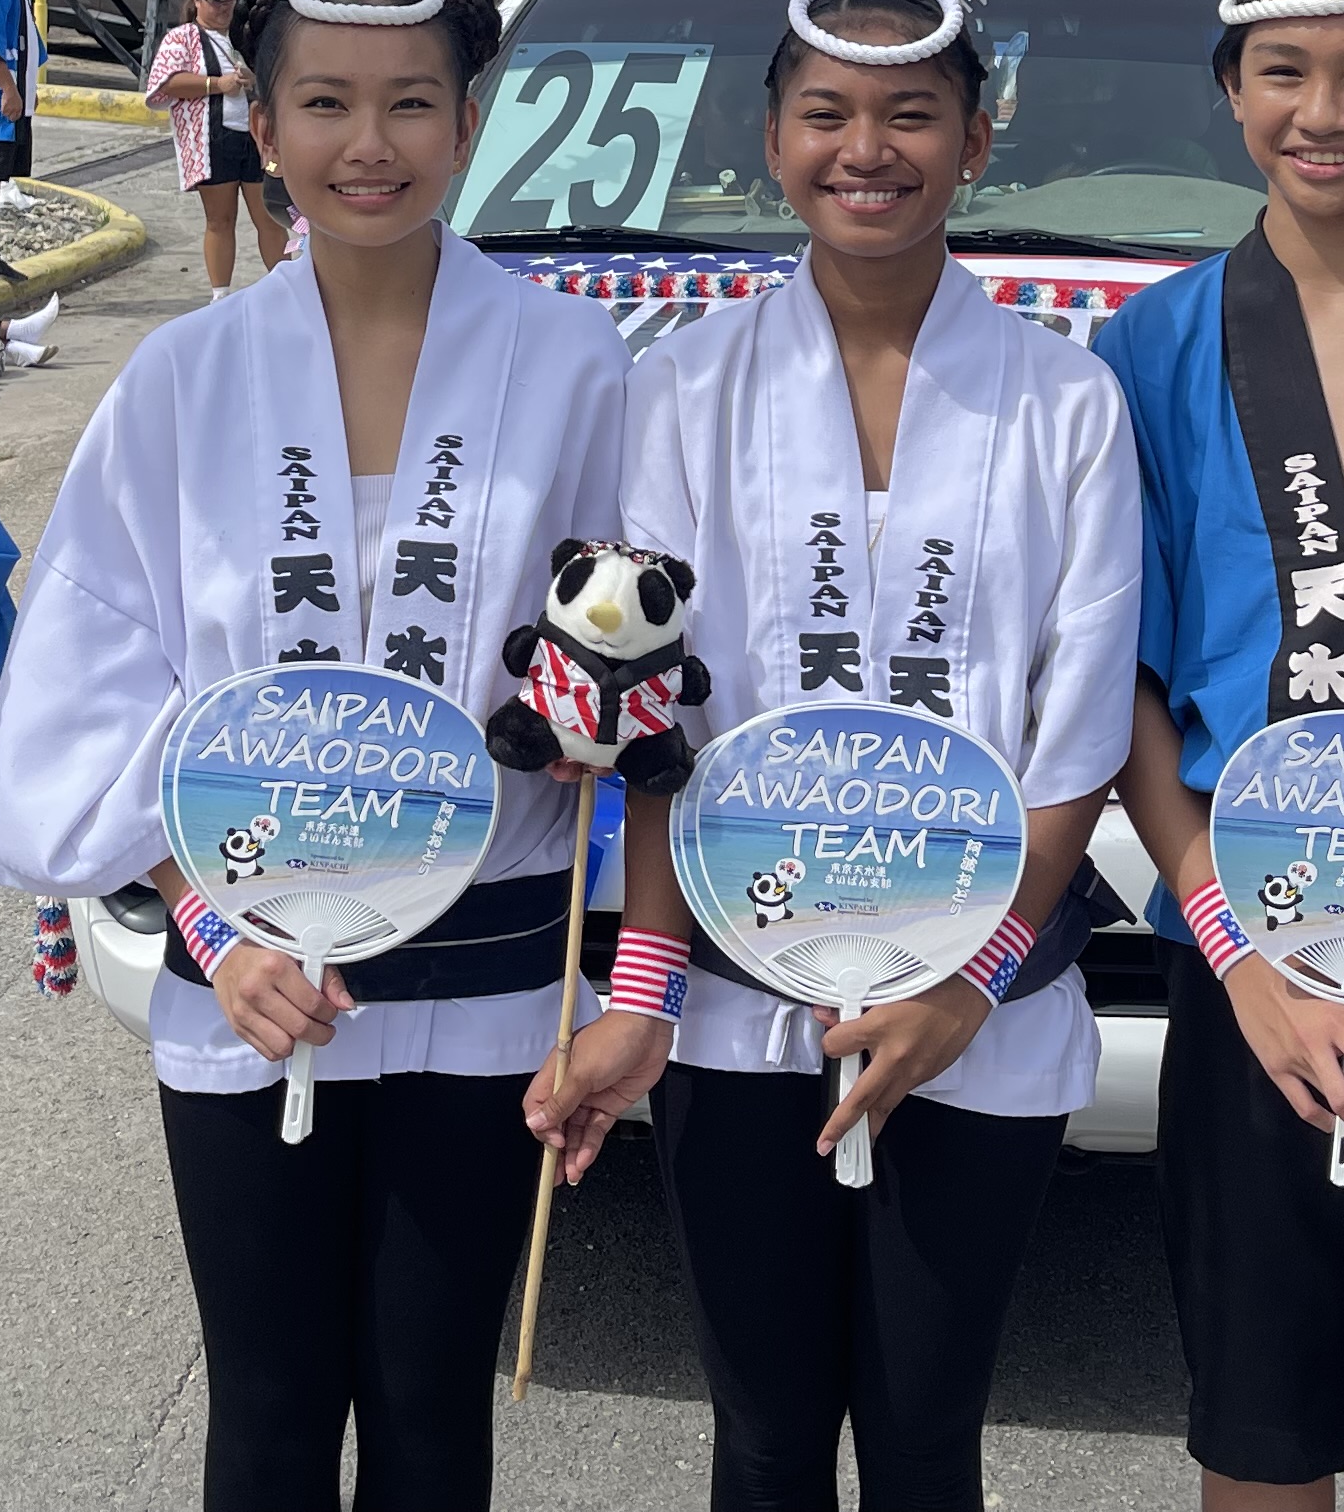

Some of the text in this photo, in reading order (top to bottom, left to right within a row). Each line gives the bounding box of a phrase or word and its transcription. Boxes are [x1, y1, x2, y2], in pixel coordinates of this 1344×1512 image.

[467, 49, 687, 236] 25
[277, 446, 321, 541] SAIPAN
[415, 434, 464, 528] SAIPAN
[1284, 453, 1338, 556] SAIPAN
[805, 512, 849, 617] SAIPAN
[906, 538, 956, 643] SAIPAN
[252, 685, 434, 737] SAIPAN
[197, 725, 476, 788] AWAODORI
[766, 727, 951, 775] SAIPAN
[260, 781, 403, 828] TEAM
[716, 769, 1000, 825] AWAODORI
[781, 823, 928, 869] TEAM
